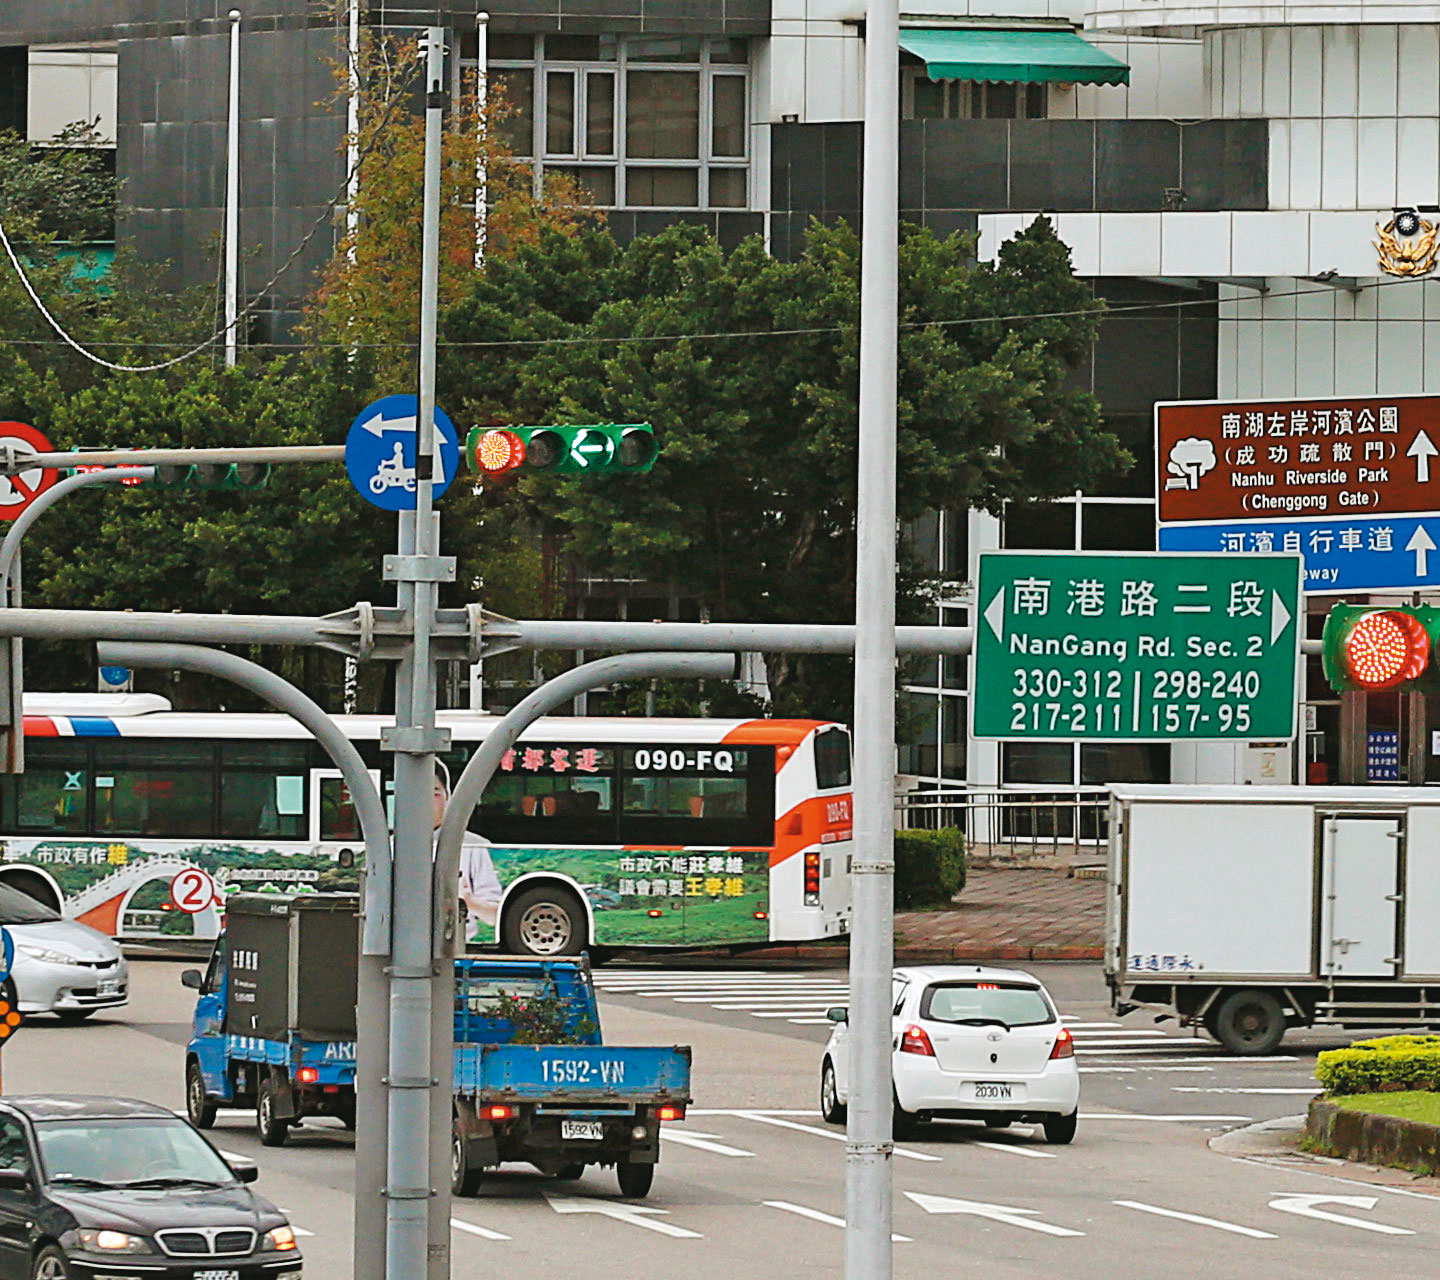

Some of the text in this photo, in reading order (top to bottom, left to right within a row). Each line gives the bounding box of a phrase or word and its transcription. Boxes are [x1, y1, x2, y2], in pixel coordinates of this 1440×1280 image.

[1222, 407, 1398, 439] 南湖左岸河濱公園
[1232, 467, 1388, 487] Nanhu Riverside Park
[1242, 490, 1380, 511] (Chenggong Gate)
[1220, 527, 1394, 553] 河濱自行車道
[1013, 576, 1265, 617] 南港路二段
[1010, 634, 1263, 663] NanGang Rd. Sec. 2
[1013, 669, 1260, 699] 330-312 298-240
[1010, 703, 1121, 732] 217-211
[634, 749, 734, 772] 090-FQ
[182, 874, 203, 905] 2
[542, 1059, 625, 1083] 1592-VN
